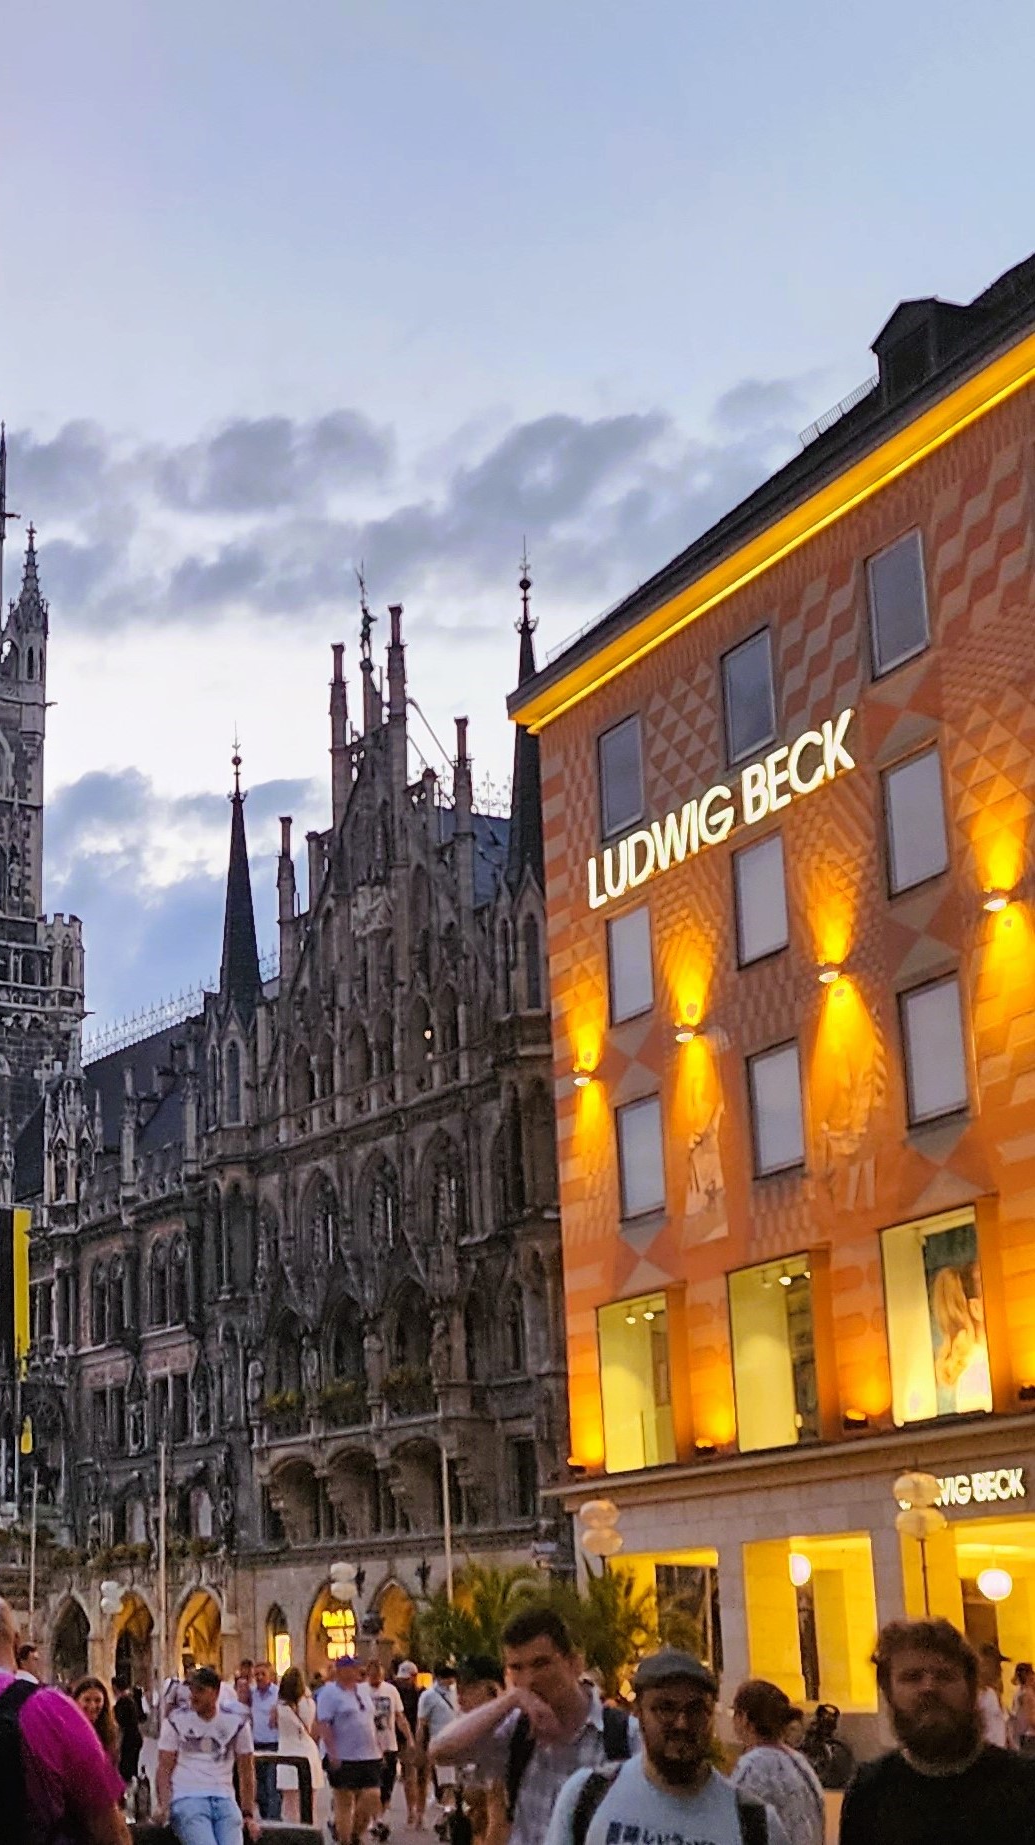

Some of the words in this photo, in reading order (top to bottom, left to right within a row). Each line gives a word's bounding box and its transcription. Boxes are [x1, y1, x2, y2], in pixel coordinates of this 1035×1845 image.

[587, 785, 735, 910] LUDWIG
[741, 708, 856, 826] BECK
[970, 1467, 1026, 1503] BECK
